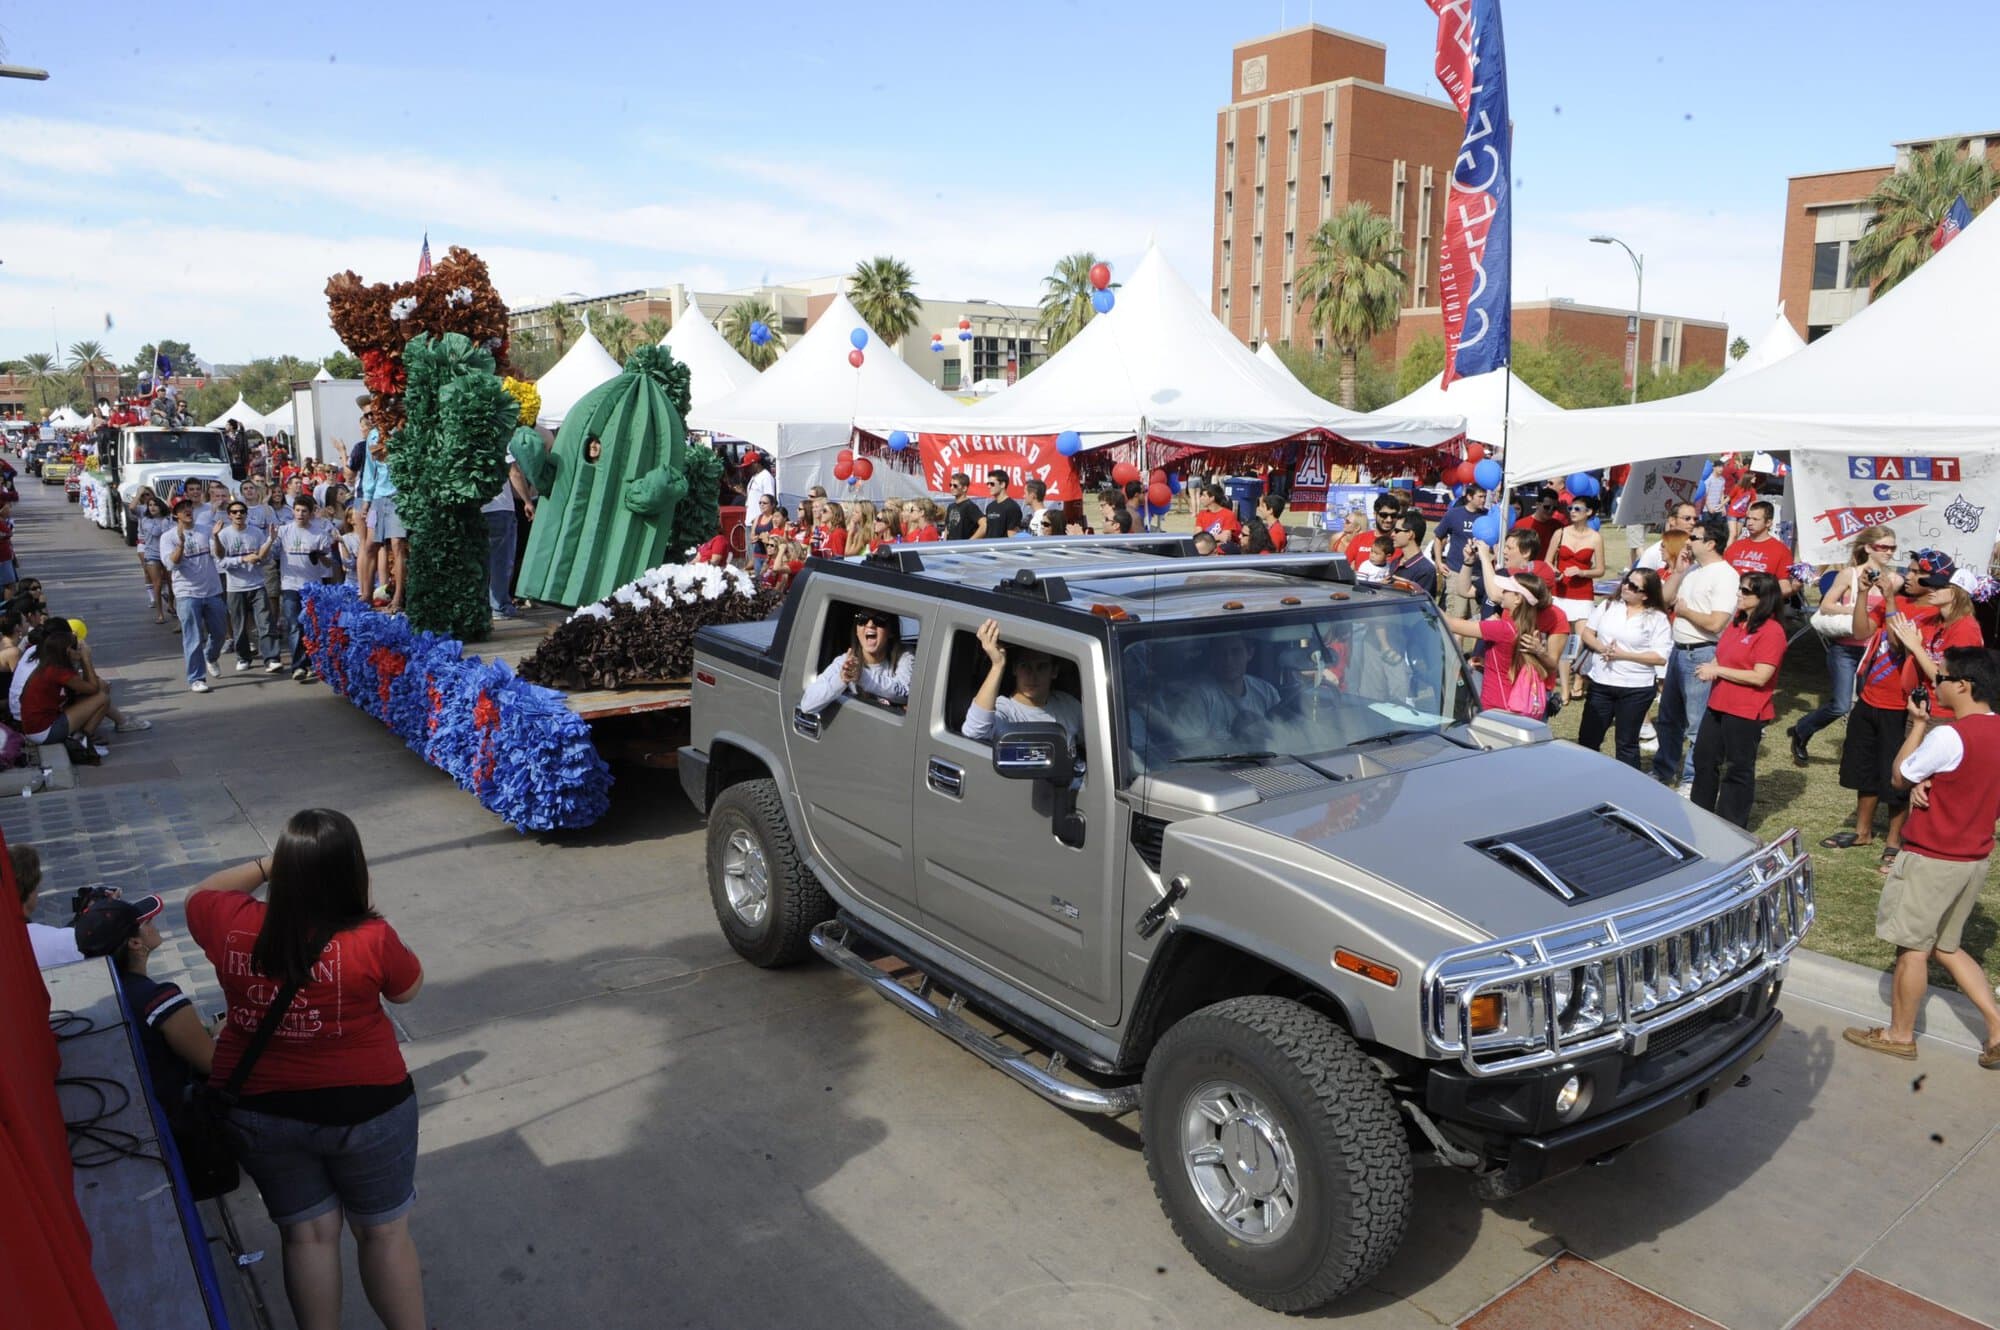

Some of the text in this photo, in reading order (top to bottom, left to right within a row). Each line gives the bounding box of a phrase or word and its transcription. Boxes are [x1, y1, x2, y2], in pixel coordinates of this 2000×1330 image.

[932, 435, 970, 491] HAPPY
[1854, 458, 1954, 479] SALT
[1872, 483, 1938, 501] Center
[1838, 507, 1897, 539] Aged
[1917, 514, 1941, 538] to
[247, 984, 309, 1009] CLAS
